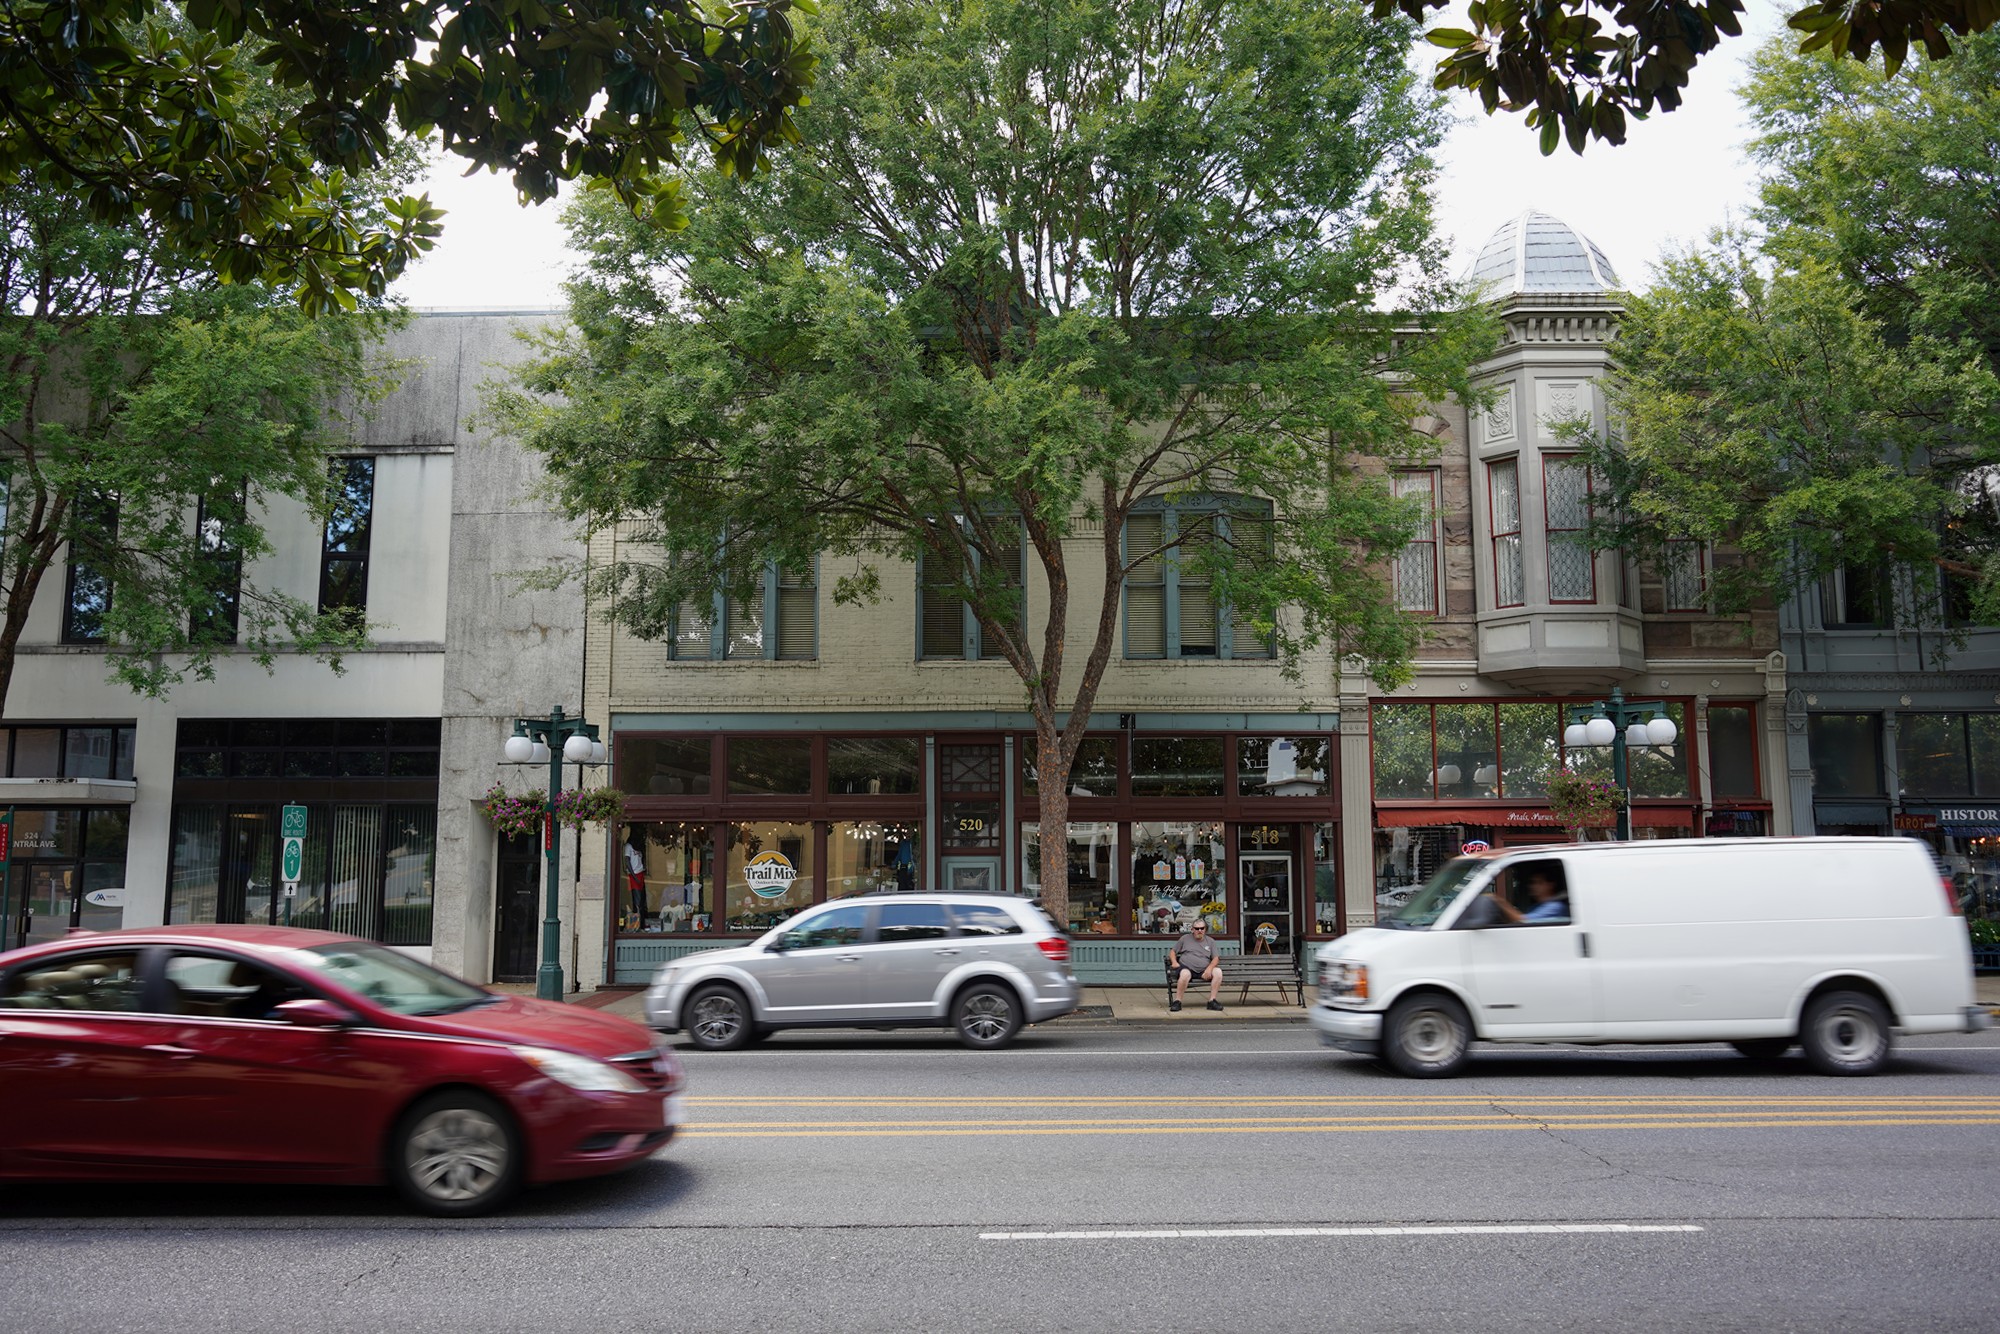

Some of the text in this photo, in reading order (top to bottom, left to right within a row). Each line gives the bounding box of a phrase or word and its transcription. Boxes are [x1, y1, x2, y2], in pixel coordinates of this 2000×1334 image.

[1941, 809, 2000, 821] HISTOR
[959, 819, 983, 830] 520
[1895, 817, 1924, 829] TAROT
[24, 832, 38, 840] 524
[1251, 829, 1280, 844] 518
[13, 840, 57, 848] NTRAL AVE.
[1461, 844, 1489, 853] OPEN
[290, 860, 294, 871] 1
[745, 867, 796, 880] Trail Mix
[1162, 884, 1180, 898] Gift
[1179, 884, 1209, 899] Gallery
